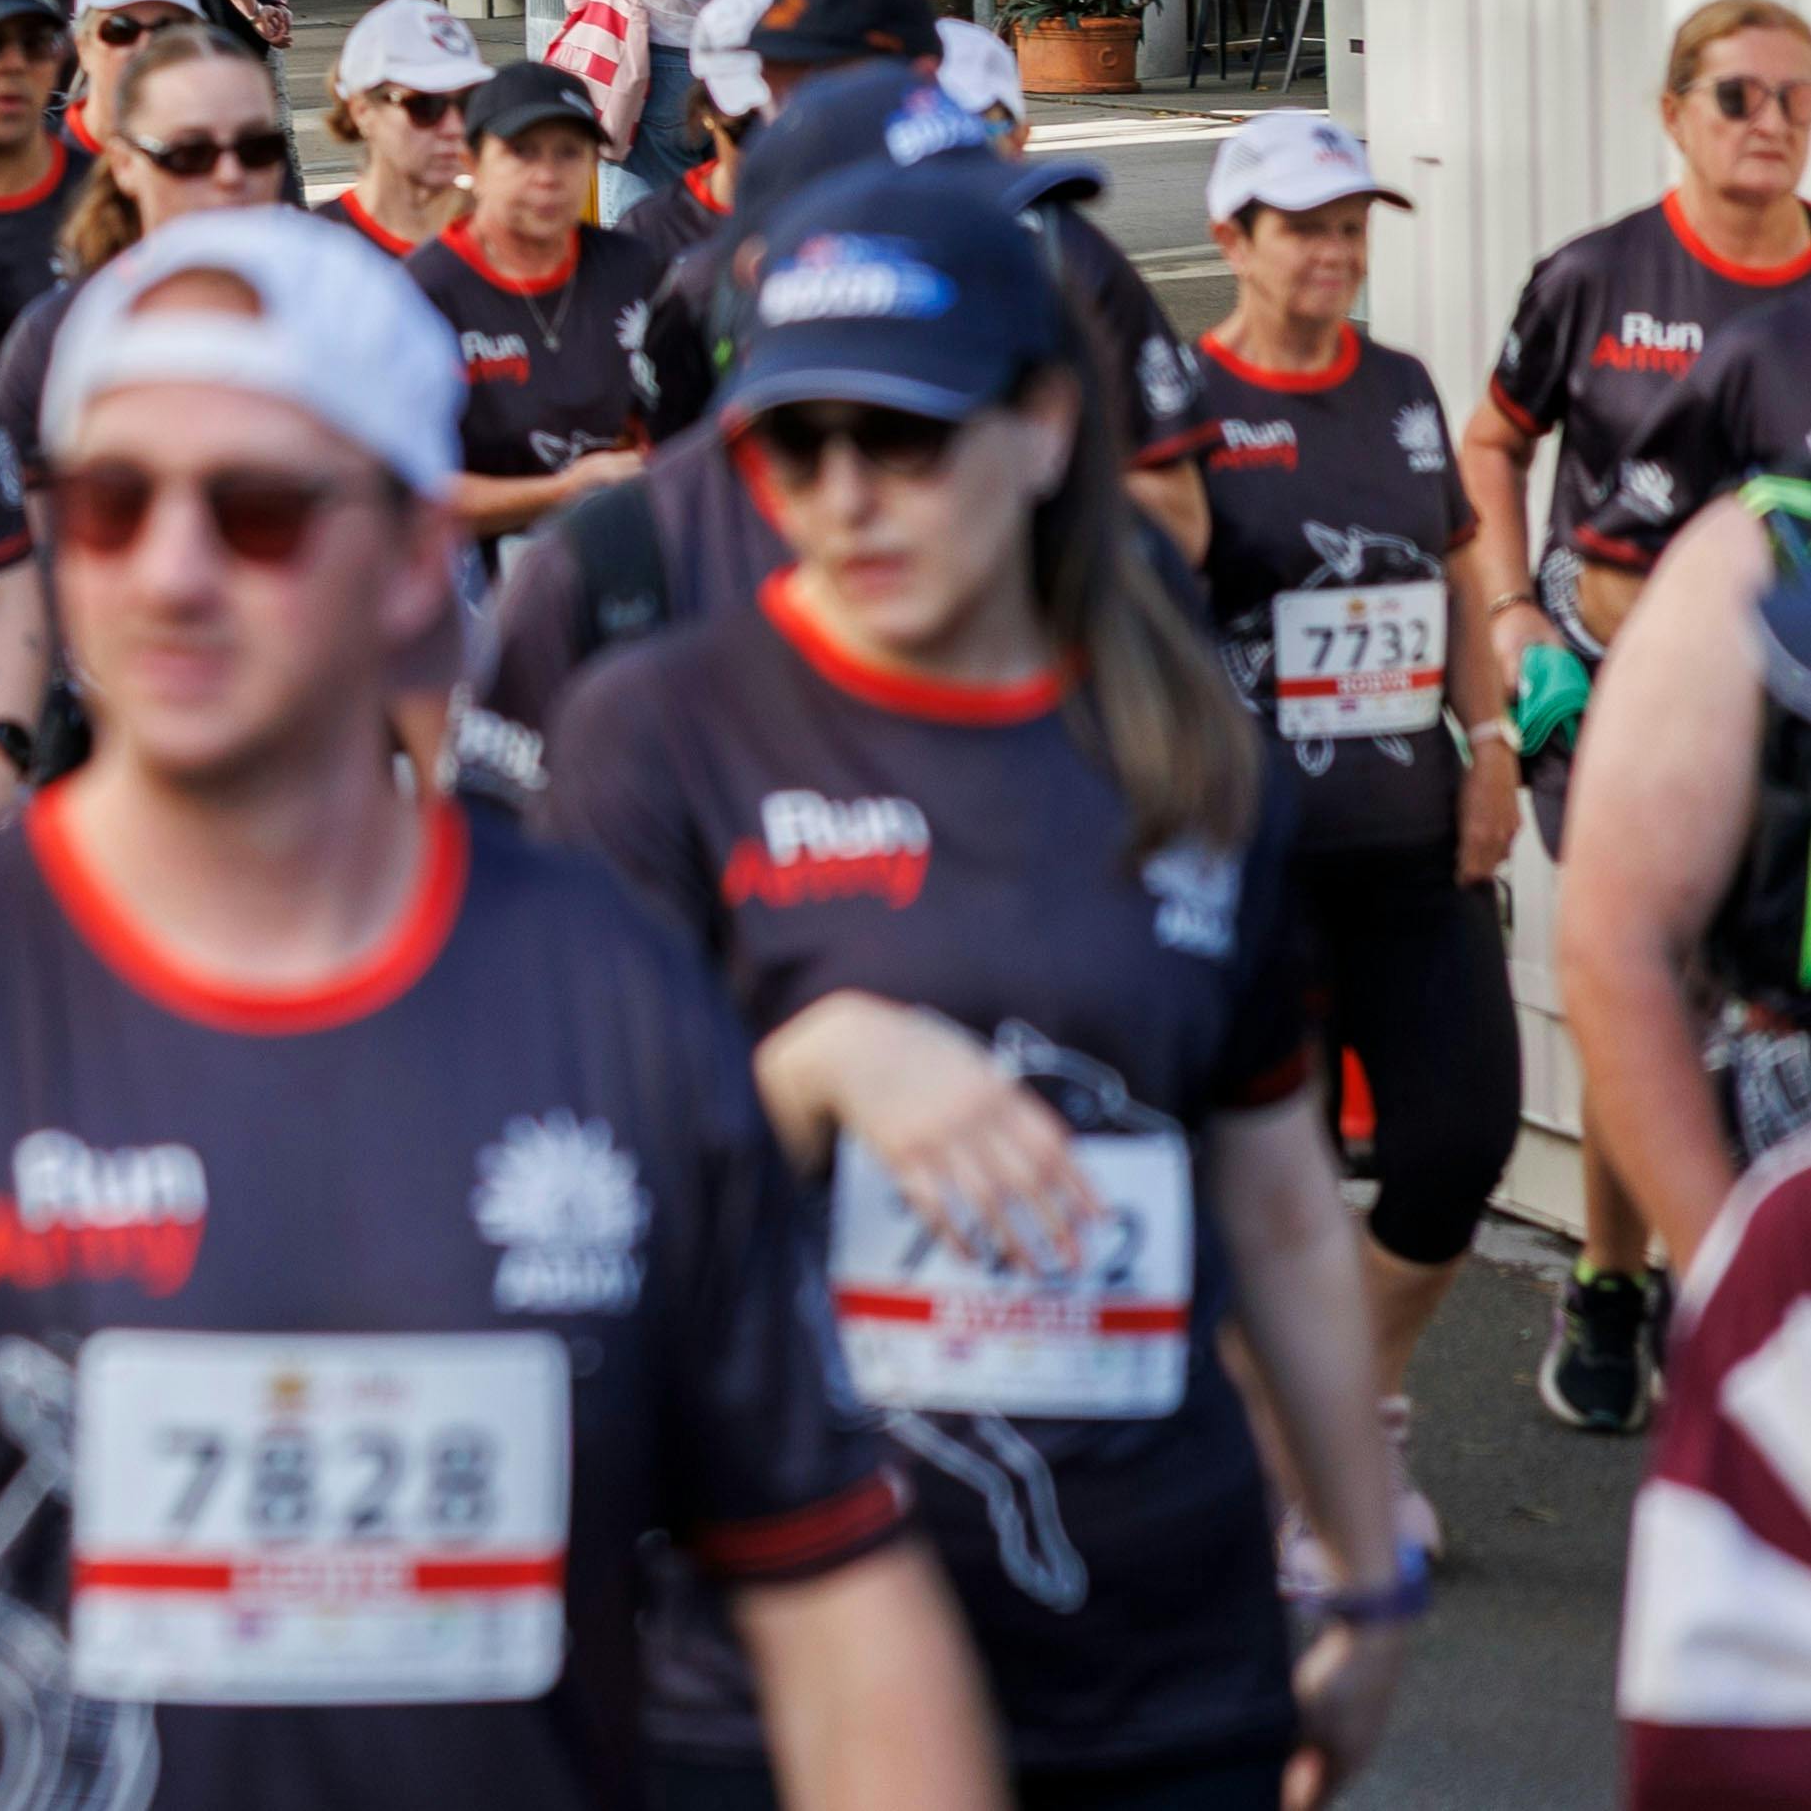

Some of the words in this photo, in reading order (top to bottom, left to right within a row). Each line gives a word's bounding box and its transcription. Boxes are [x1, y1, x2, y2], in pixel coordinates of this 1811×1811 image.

[462, 331, 529, 363] Run
[1622, 312, 1704, 354] Run
[1221, 419, 1297, 451] Run
[1303, 619, 1430, 671] 7732
[762, 789, 930, 867] Run
[152, 1427, 500, 1549] 7828
